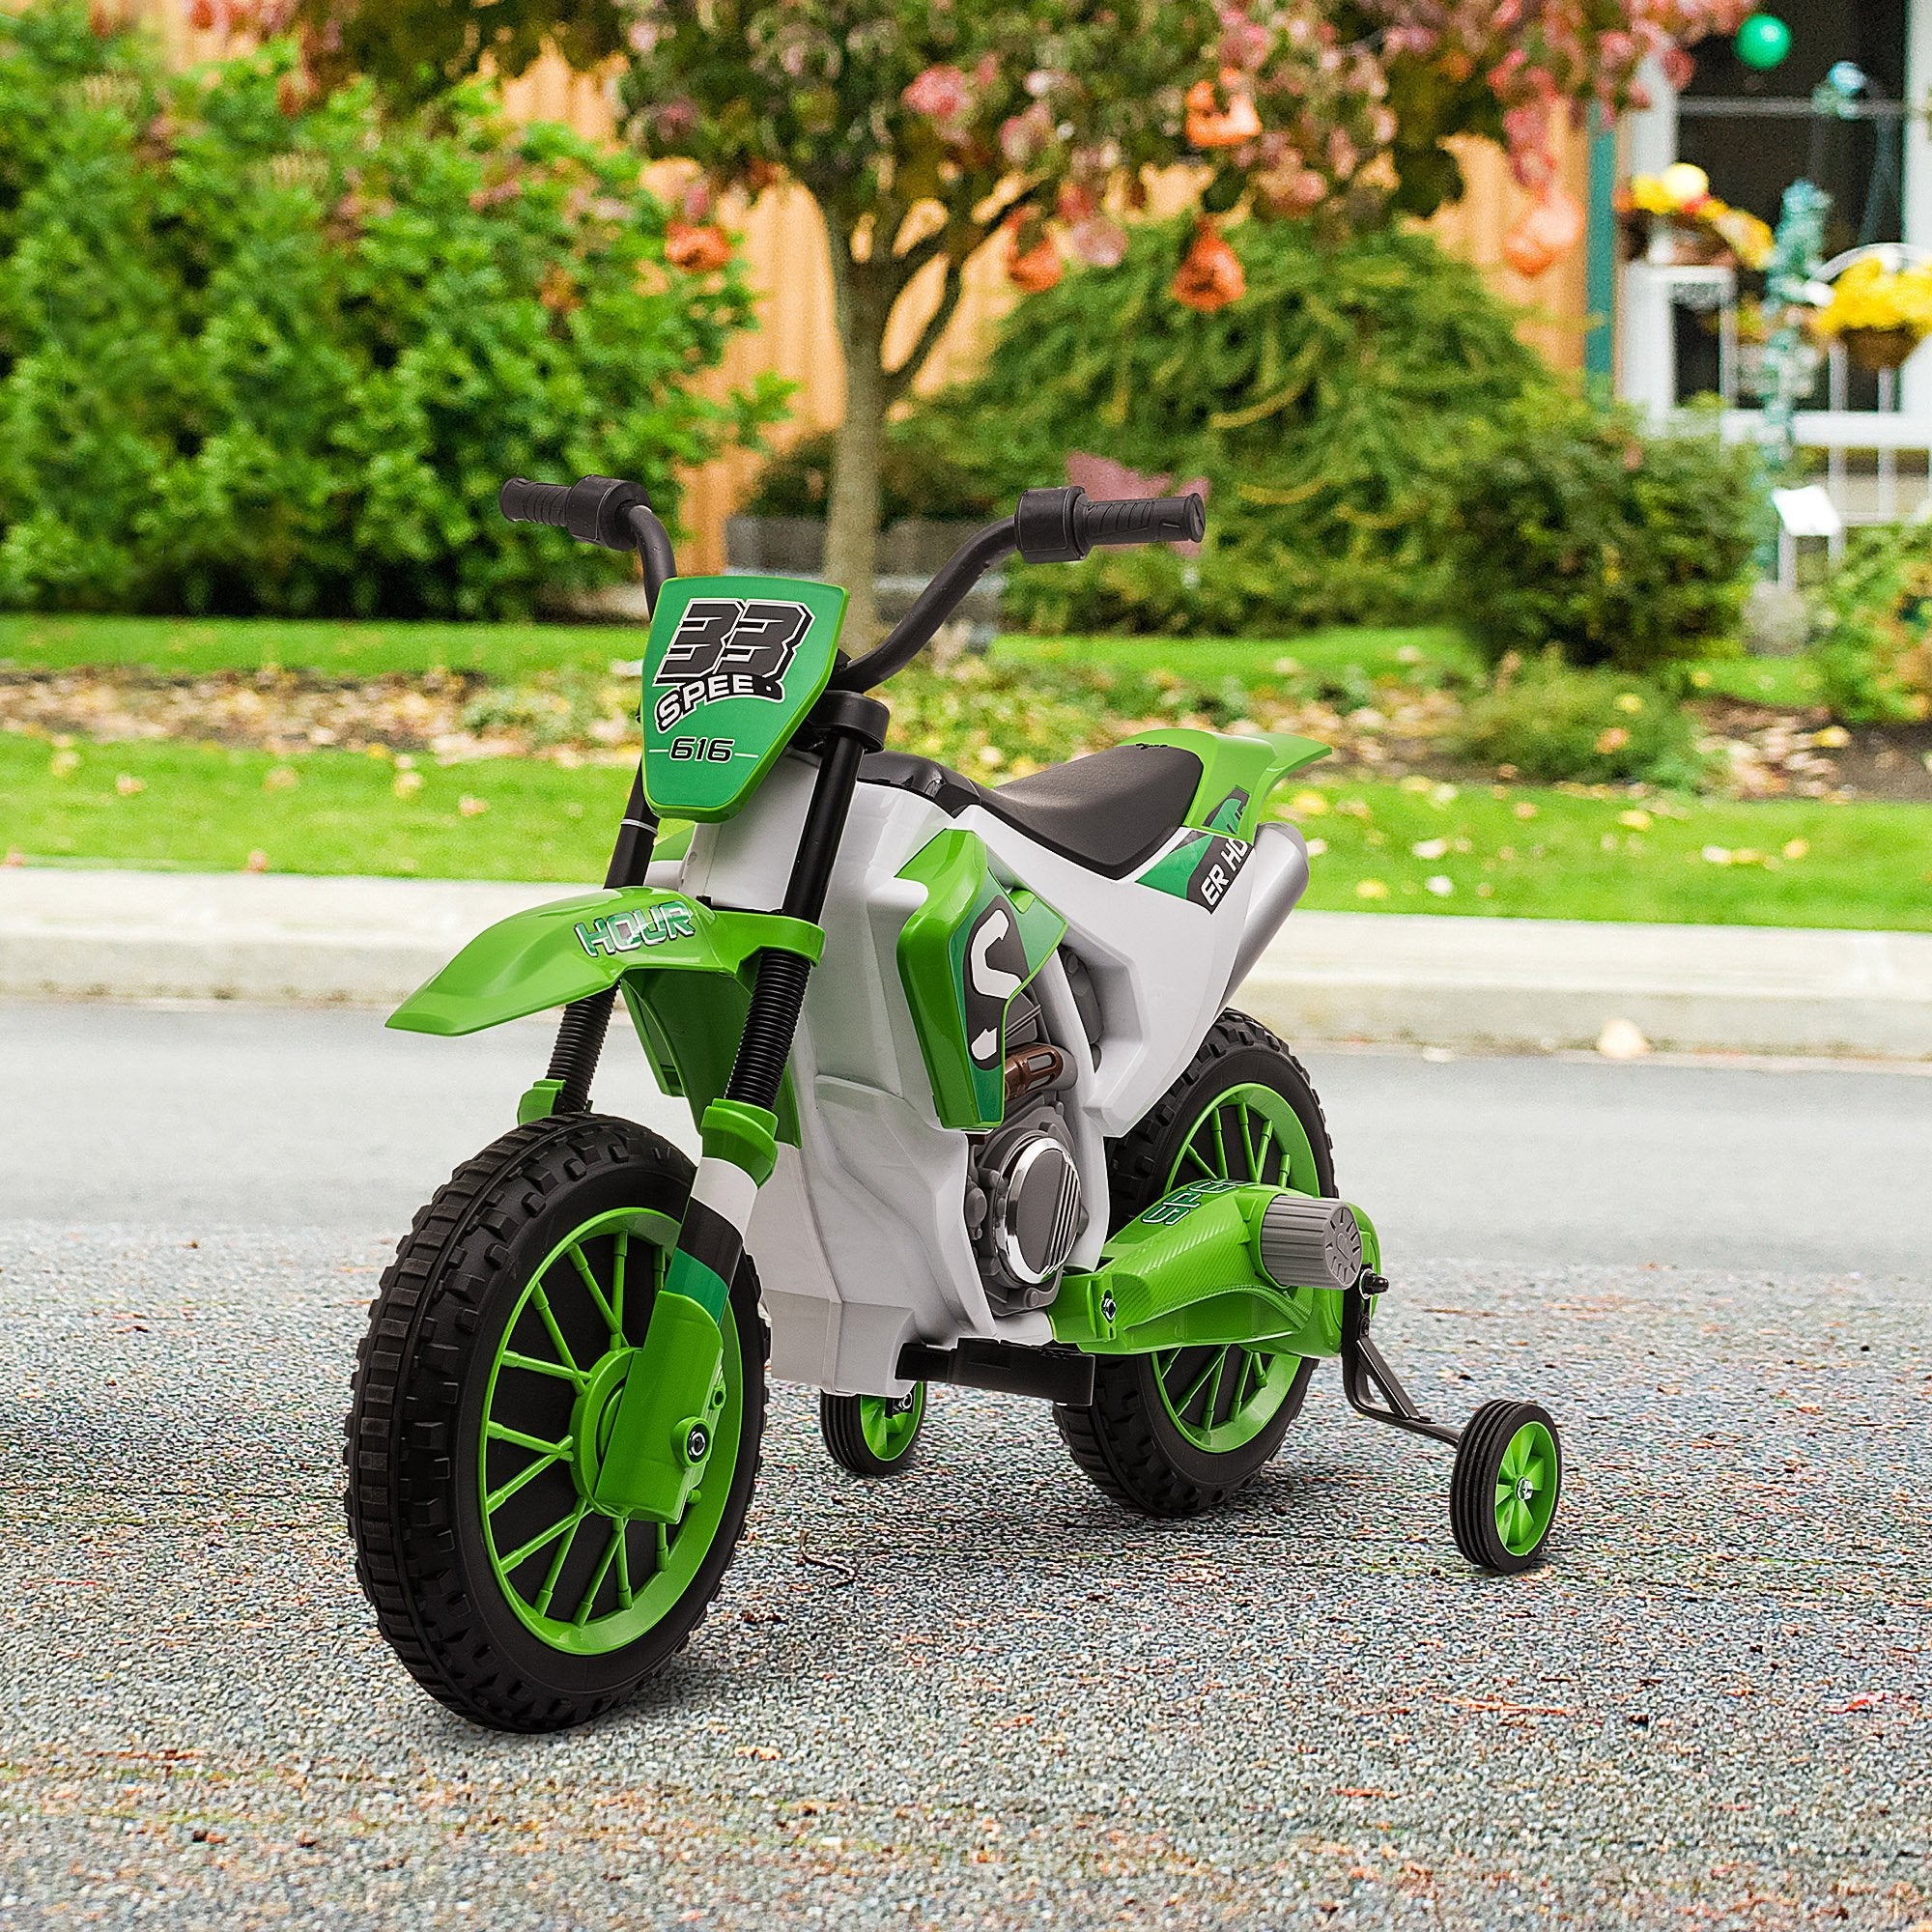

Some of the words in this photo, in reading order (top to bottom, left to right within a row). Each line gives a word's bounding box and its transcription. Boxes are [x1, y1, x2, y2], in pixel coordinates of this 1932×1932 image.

[653, 598, 815, 686] 33
[669, 737, 734, 762] 616
[1201, 864, 1230, 906] ER
[574, 900, 696, 957] HOUR
